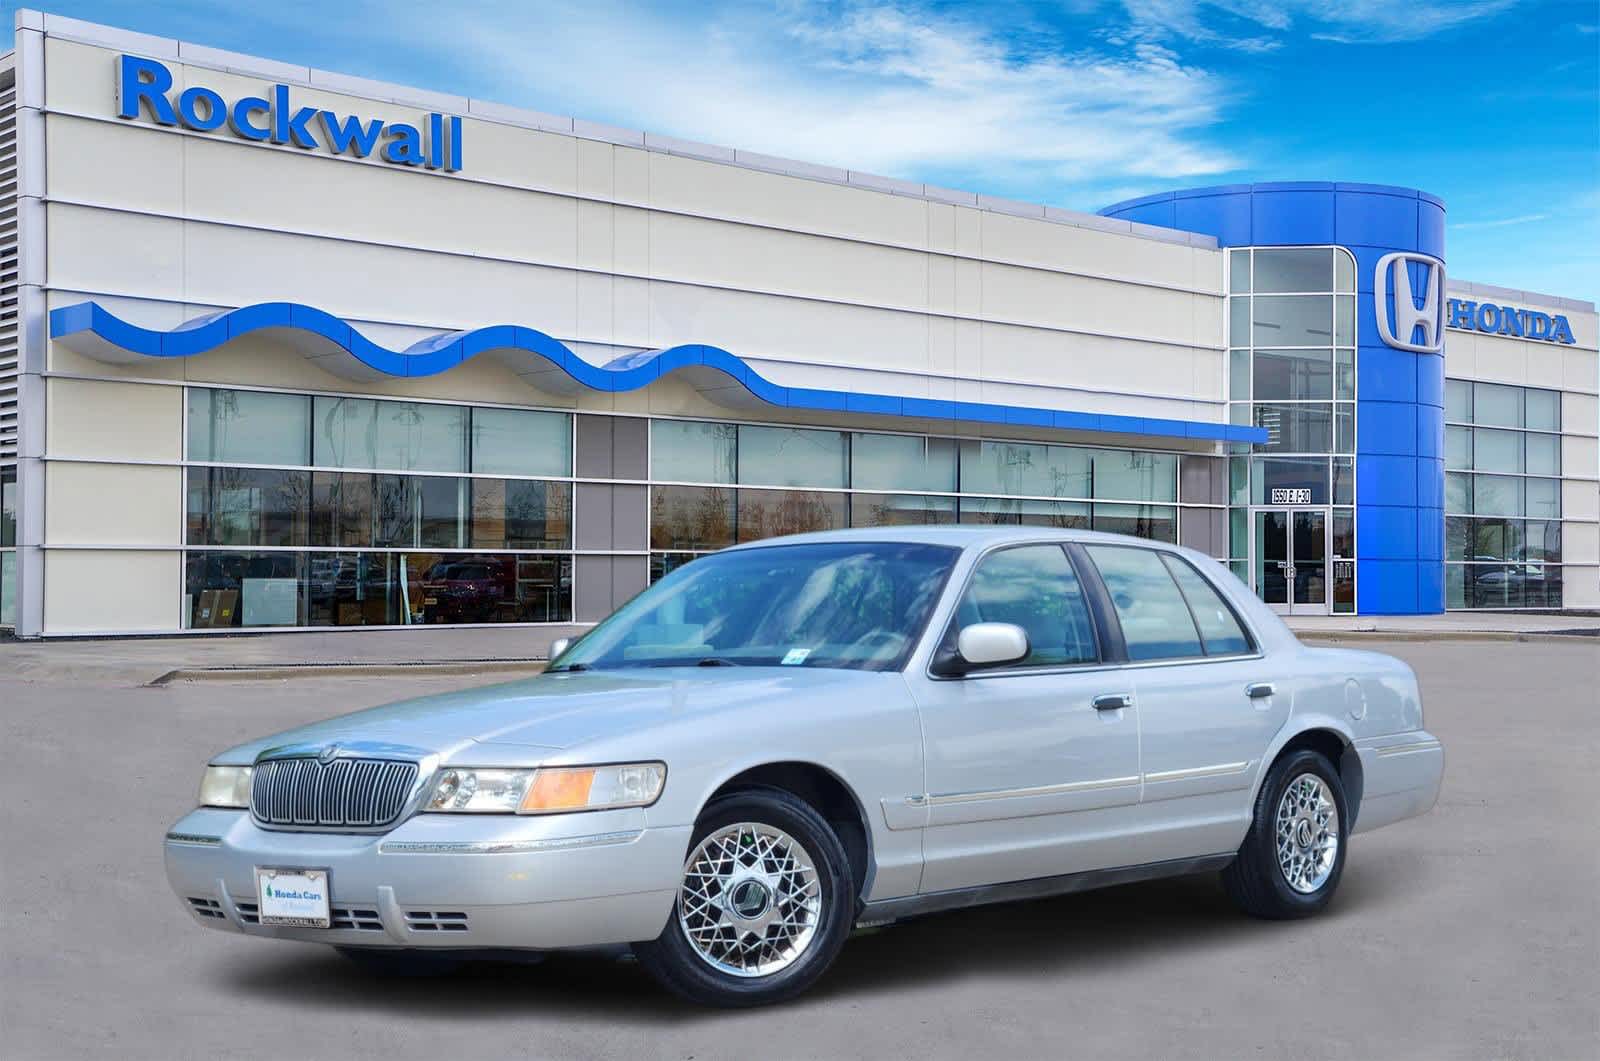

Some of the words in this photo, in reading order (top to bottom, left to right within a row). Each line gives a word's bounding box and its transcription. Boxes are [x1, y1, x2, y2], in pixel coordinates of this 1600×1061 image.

[117, 53, 463, 173] Rockwall
[1447, 298, 1576, 344] HONDA
[274, 890, 302, 899] Honda
[303, 891, 321, 900] Cars
